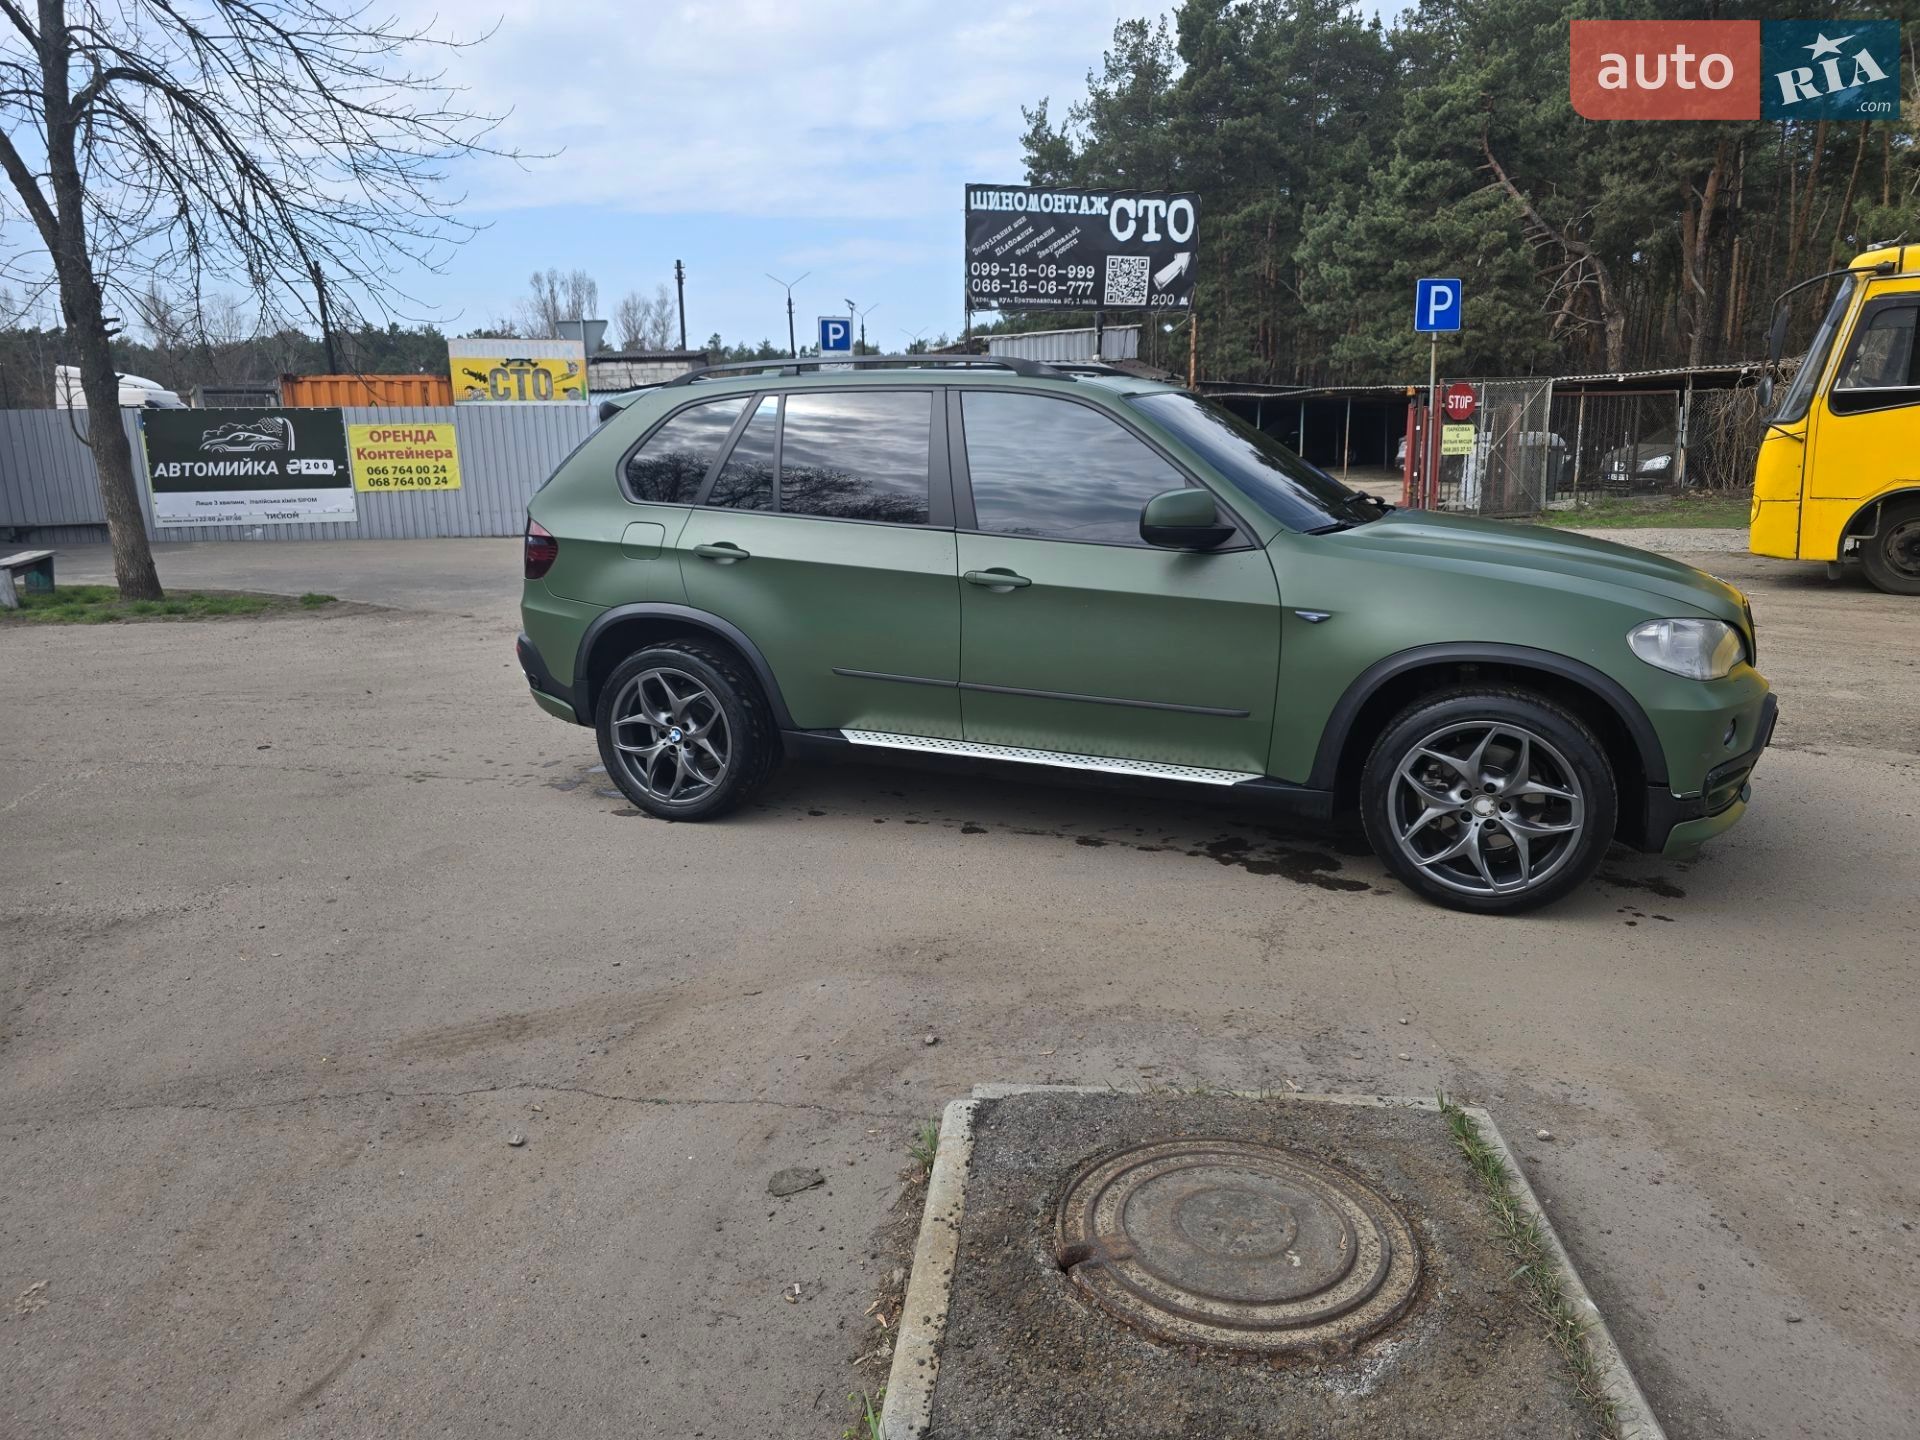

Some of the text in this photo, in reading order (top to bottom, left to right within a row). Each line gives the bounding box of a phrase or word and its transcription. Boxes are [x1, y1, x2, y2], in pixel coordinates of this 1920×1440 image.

[970, 191, 1109, 216] ШИНОМОНТАЖ
[1109, 198, 1195, 243] СТО
[970, 261, 1096, 279] 099-16-06-999
[972, 278, 1095, 296] 066-16-06-777
[1151, 293, 1175, 306] 200
[1429, 285, 1453, 325] P
[828, 322, 845, 348] P
[489, 367, 553, 401] СТО
[1448, 395, 1473, 409] STOP
[369, 430, 437, 445] ОРЕНДА
[356, 447, 454, 462] Контейнера
[154, 458, 279, 477] АВТОМИЙКА
[367, 465, 447, 475] 066 764 00 24
[368, 476, 448, 487] 068 764 00 24
